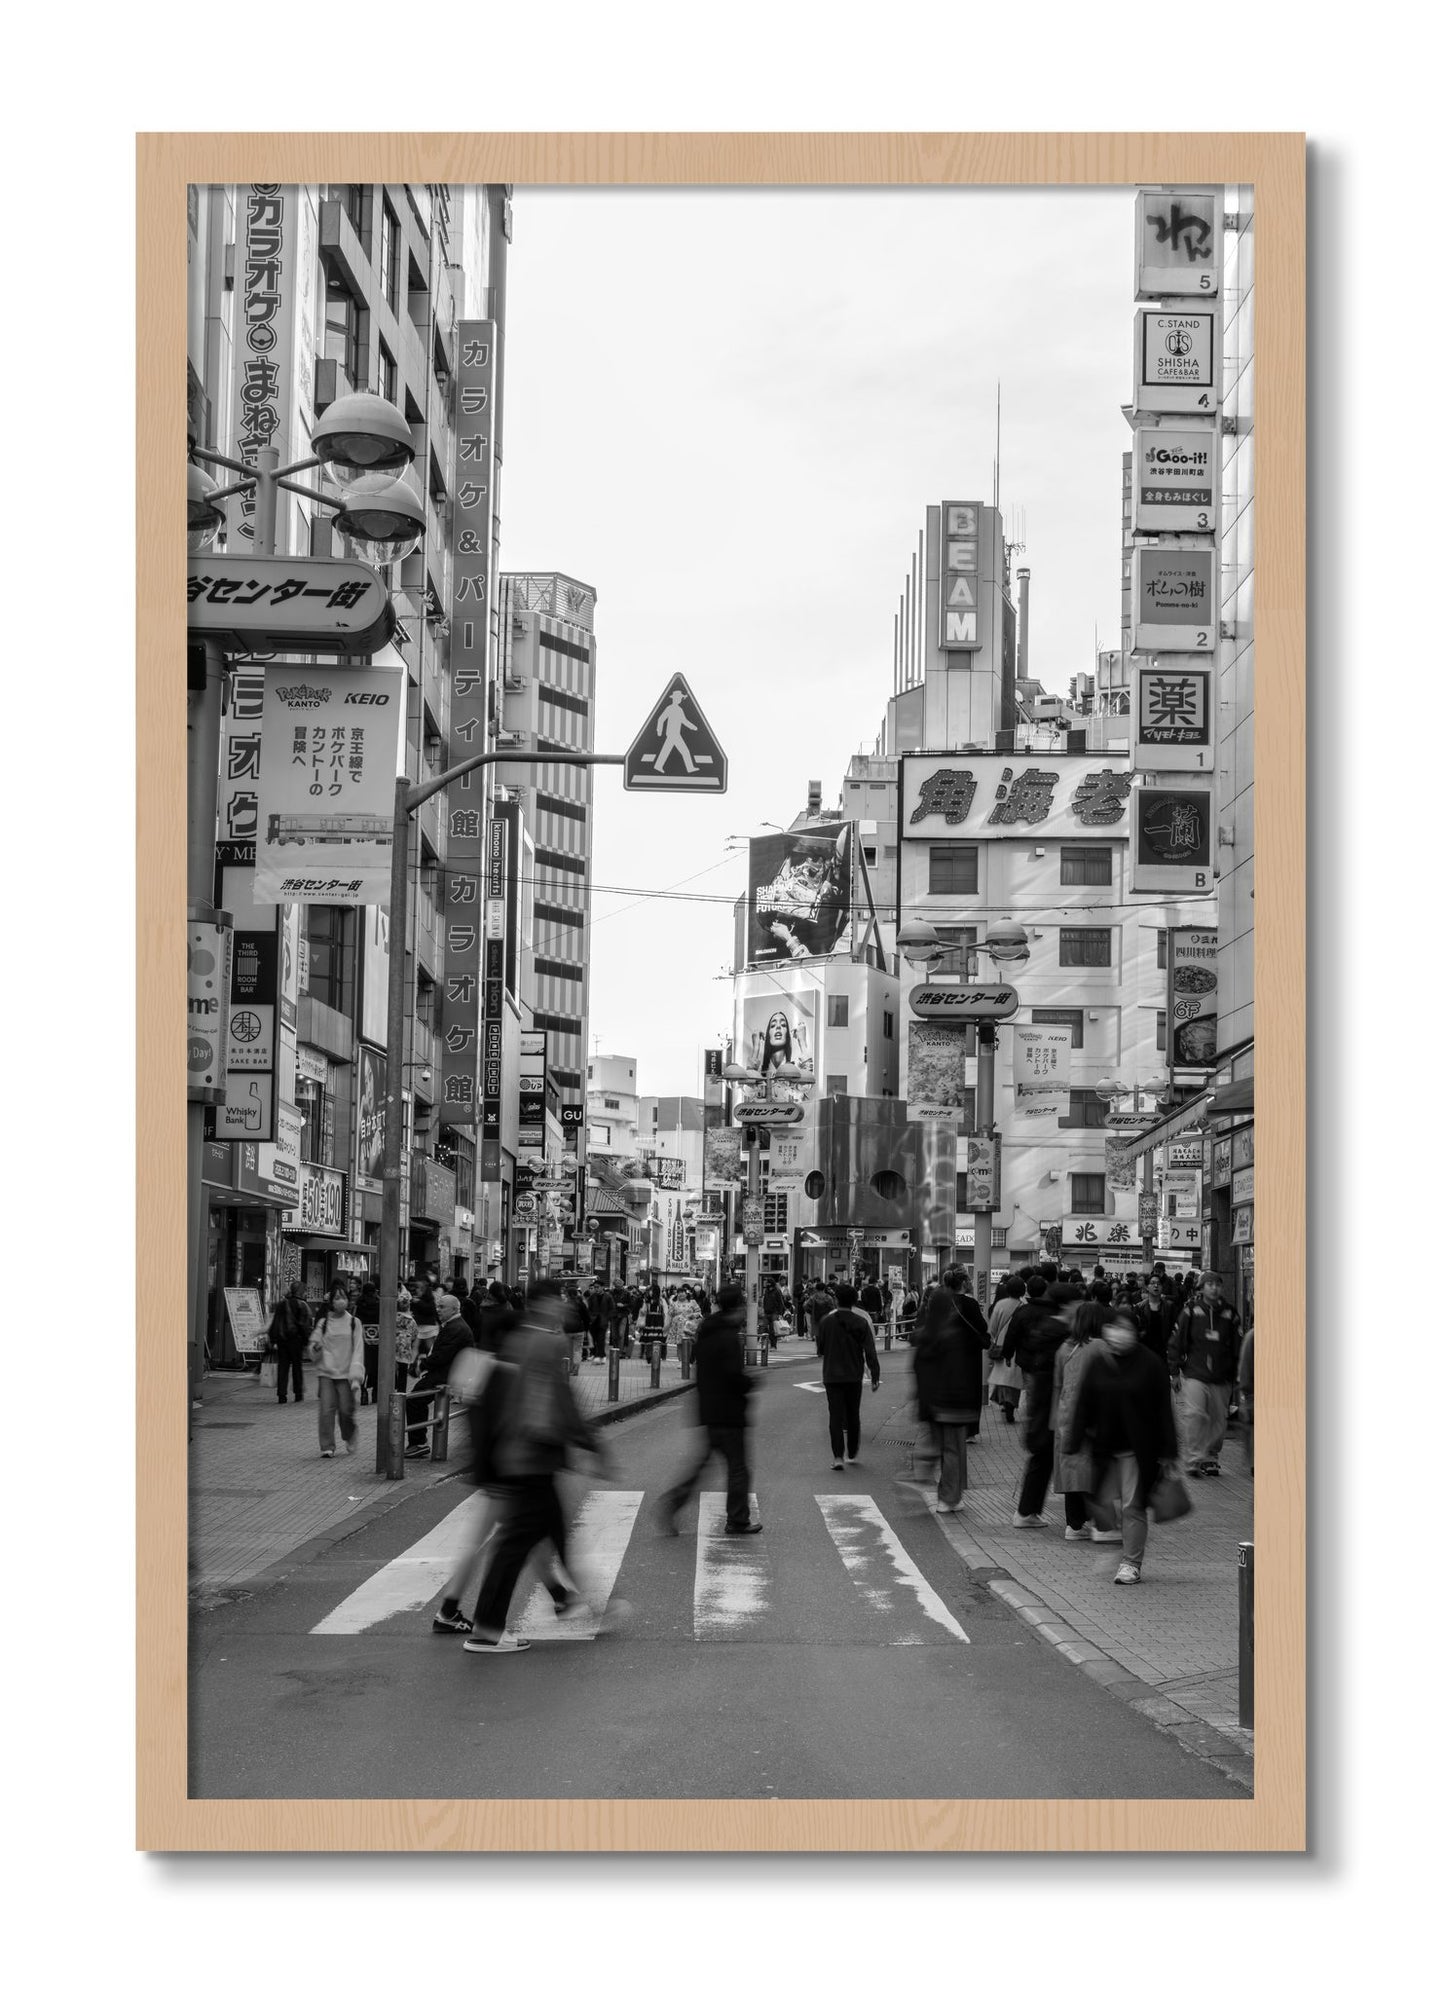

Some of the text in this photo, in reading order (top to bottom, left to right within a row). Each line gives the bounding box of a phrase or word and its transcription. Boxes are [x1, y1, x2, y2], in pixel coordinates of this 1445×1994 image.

[245, 196, 283, 325] カラオケ
[1200, 275, 1211, 290] 5
[1158, 320, 1200, 328] C.STAND
[1158, 358, 1200, 368] SHISHA
[1158, 368, 1200, 376] CAFE&BAR
[1198, 393, 1210, 408] 4
[1156, 449, 1208, 464] Goo-it!
[1149, 467, 1205, 476] 渋谷宇田川町店
[1145, 491, 1209, 502] 全身もみほぐし
[1197, 512, 1209, 528] 3
[947, 507, 977, 641] BEAM
[1196, 632, 1208, 646] 2
[344, 693, 390, 706] KEIO
[1149, 678, 1197, 726] 薬
[292, 726, 307, 767] 冒険へ
[309, 727, 326, 796] カントーの
[349, 728, 365, 783] 京王線で
[1196, 753, 1204, 767] 1
[492, 824, 501, 894] kimono hearts
[280, 879, 363, 891] 渋谷センター街
[1195, 872, 1206, 887] B
[1176, 947, 1217, 958] 四川料理
[446, 876, 477, 1103] カラオケ館
[916, 993, 1013, 1005] 渋谷センター街
[1174, 1001, 1201, 1019] 6F
[193, 1047, 212, 1060] Day!
[226, 1107, 258, 1118] Whisky
[563, 1110, 582, 1121] GU
[225, 1116, 244, 1124] Bank
[203, 1126, 214, 1136] 1F
[1075, 1222, 1131, 1243] 兆楽
